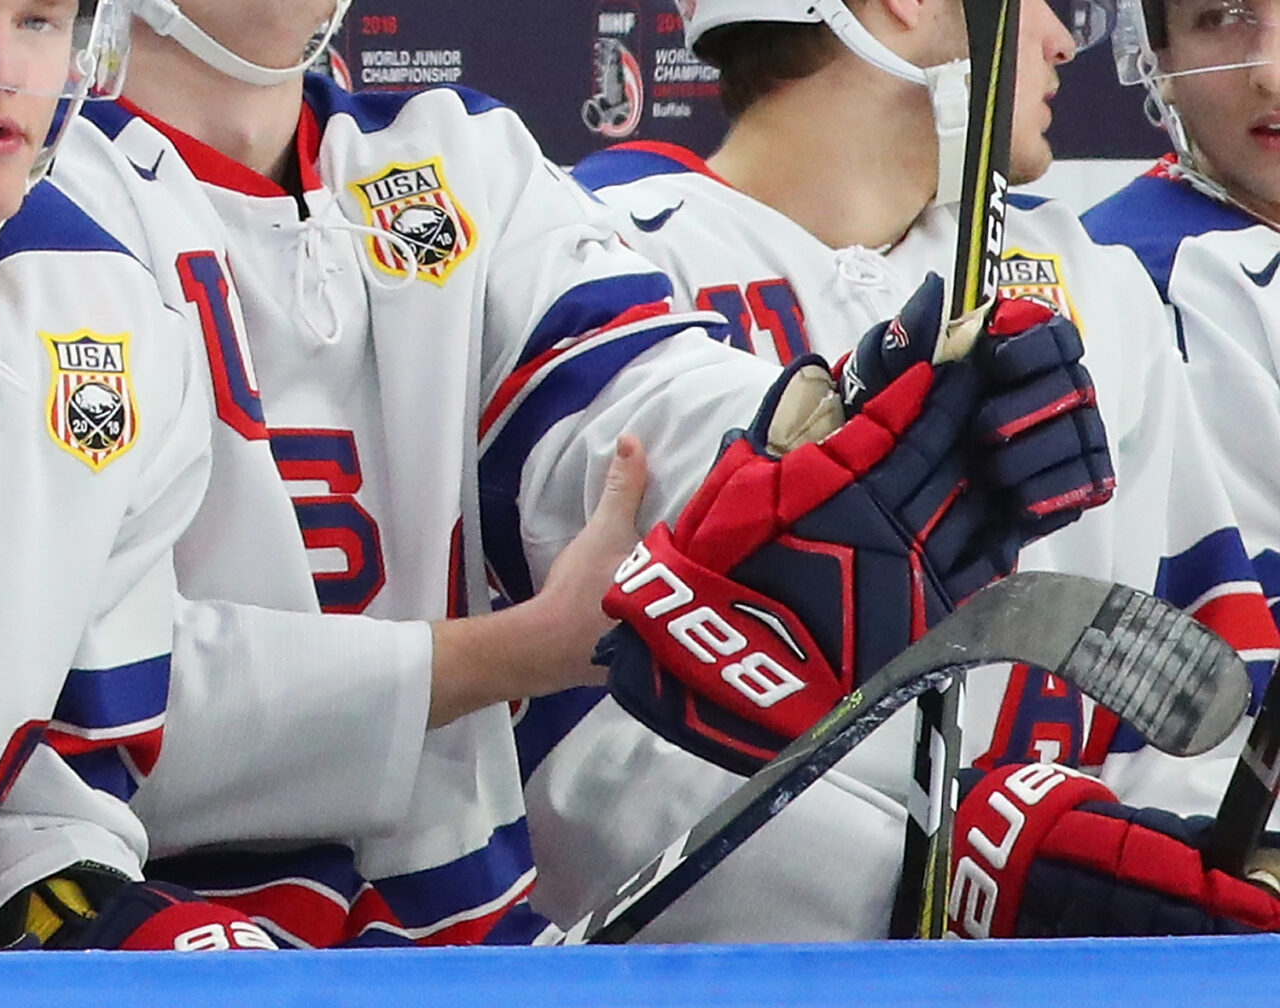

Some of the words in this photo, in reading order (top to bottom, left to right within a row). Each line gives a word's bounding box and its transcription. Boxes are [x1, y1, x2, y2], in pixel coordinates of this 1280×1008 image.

[361, 50, 410, 66] WORLD
[412, 50, 462, 66] JUNIOR
[361, 67, 462, 83] CHAMPIONSHIP
[374, 170, 433, 202] USA
[982, 170, 1008, 301] CCM
[65, 344, 118, 370] USA
[72, 419, 88, 434] 20
[106, 421, 120, 435] 18
